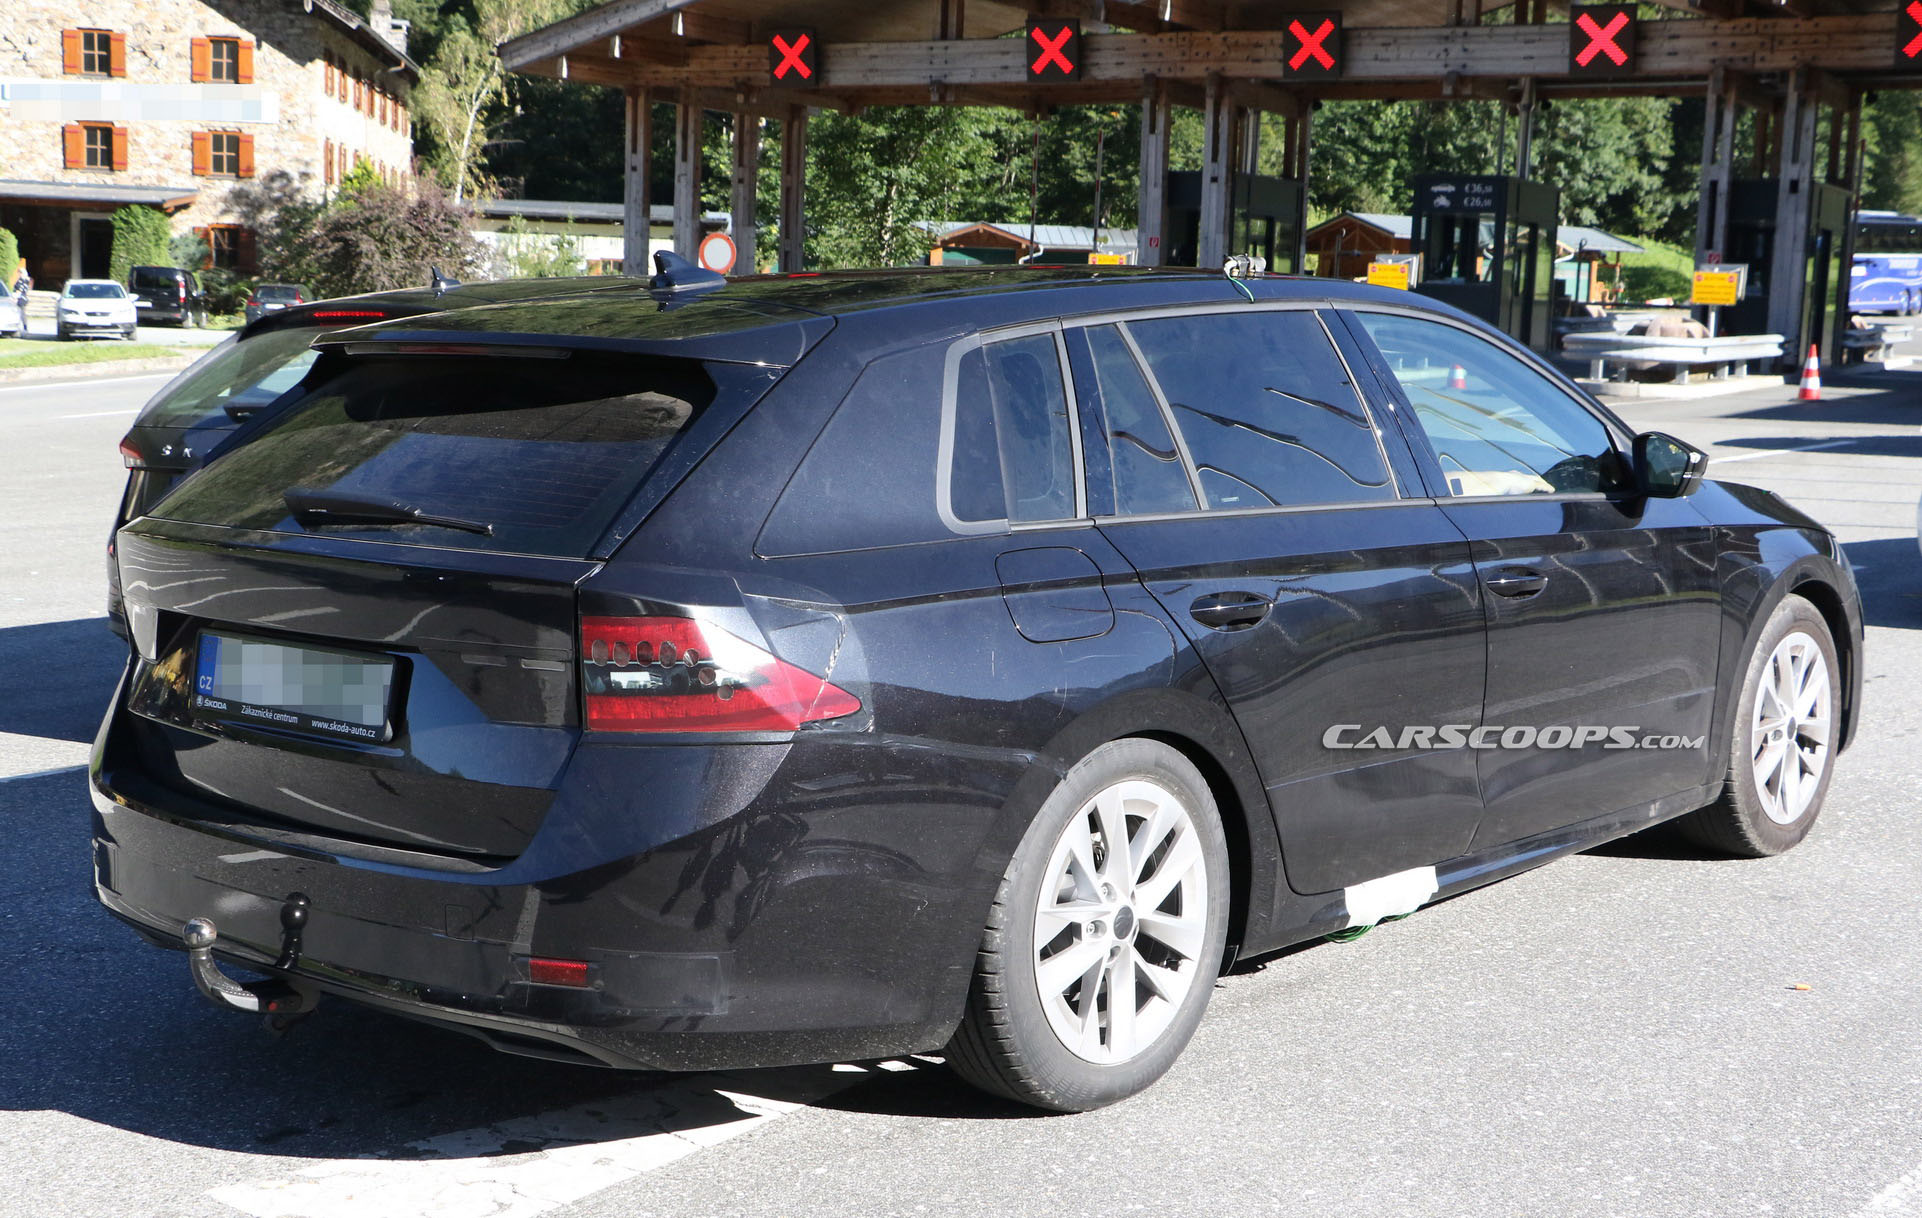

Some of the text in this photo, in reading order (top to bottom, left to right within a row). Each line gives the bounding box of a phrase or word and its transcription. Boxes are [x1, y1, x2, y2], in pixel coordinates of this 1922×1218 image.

[199, 675, 213, 690] CZ
[240, 704, 273, 720] Zákaznické
[273, 712, 299, 724] centrum
[311, 719, 376, 738] www.skoda-auto.cz
